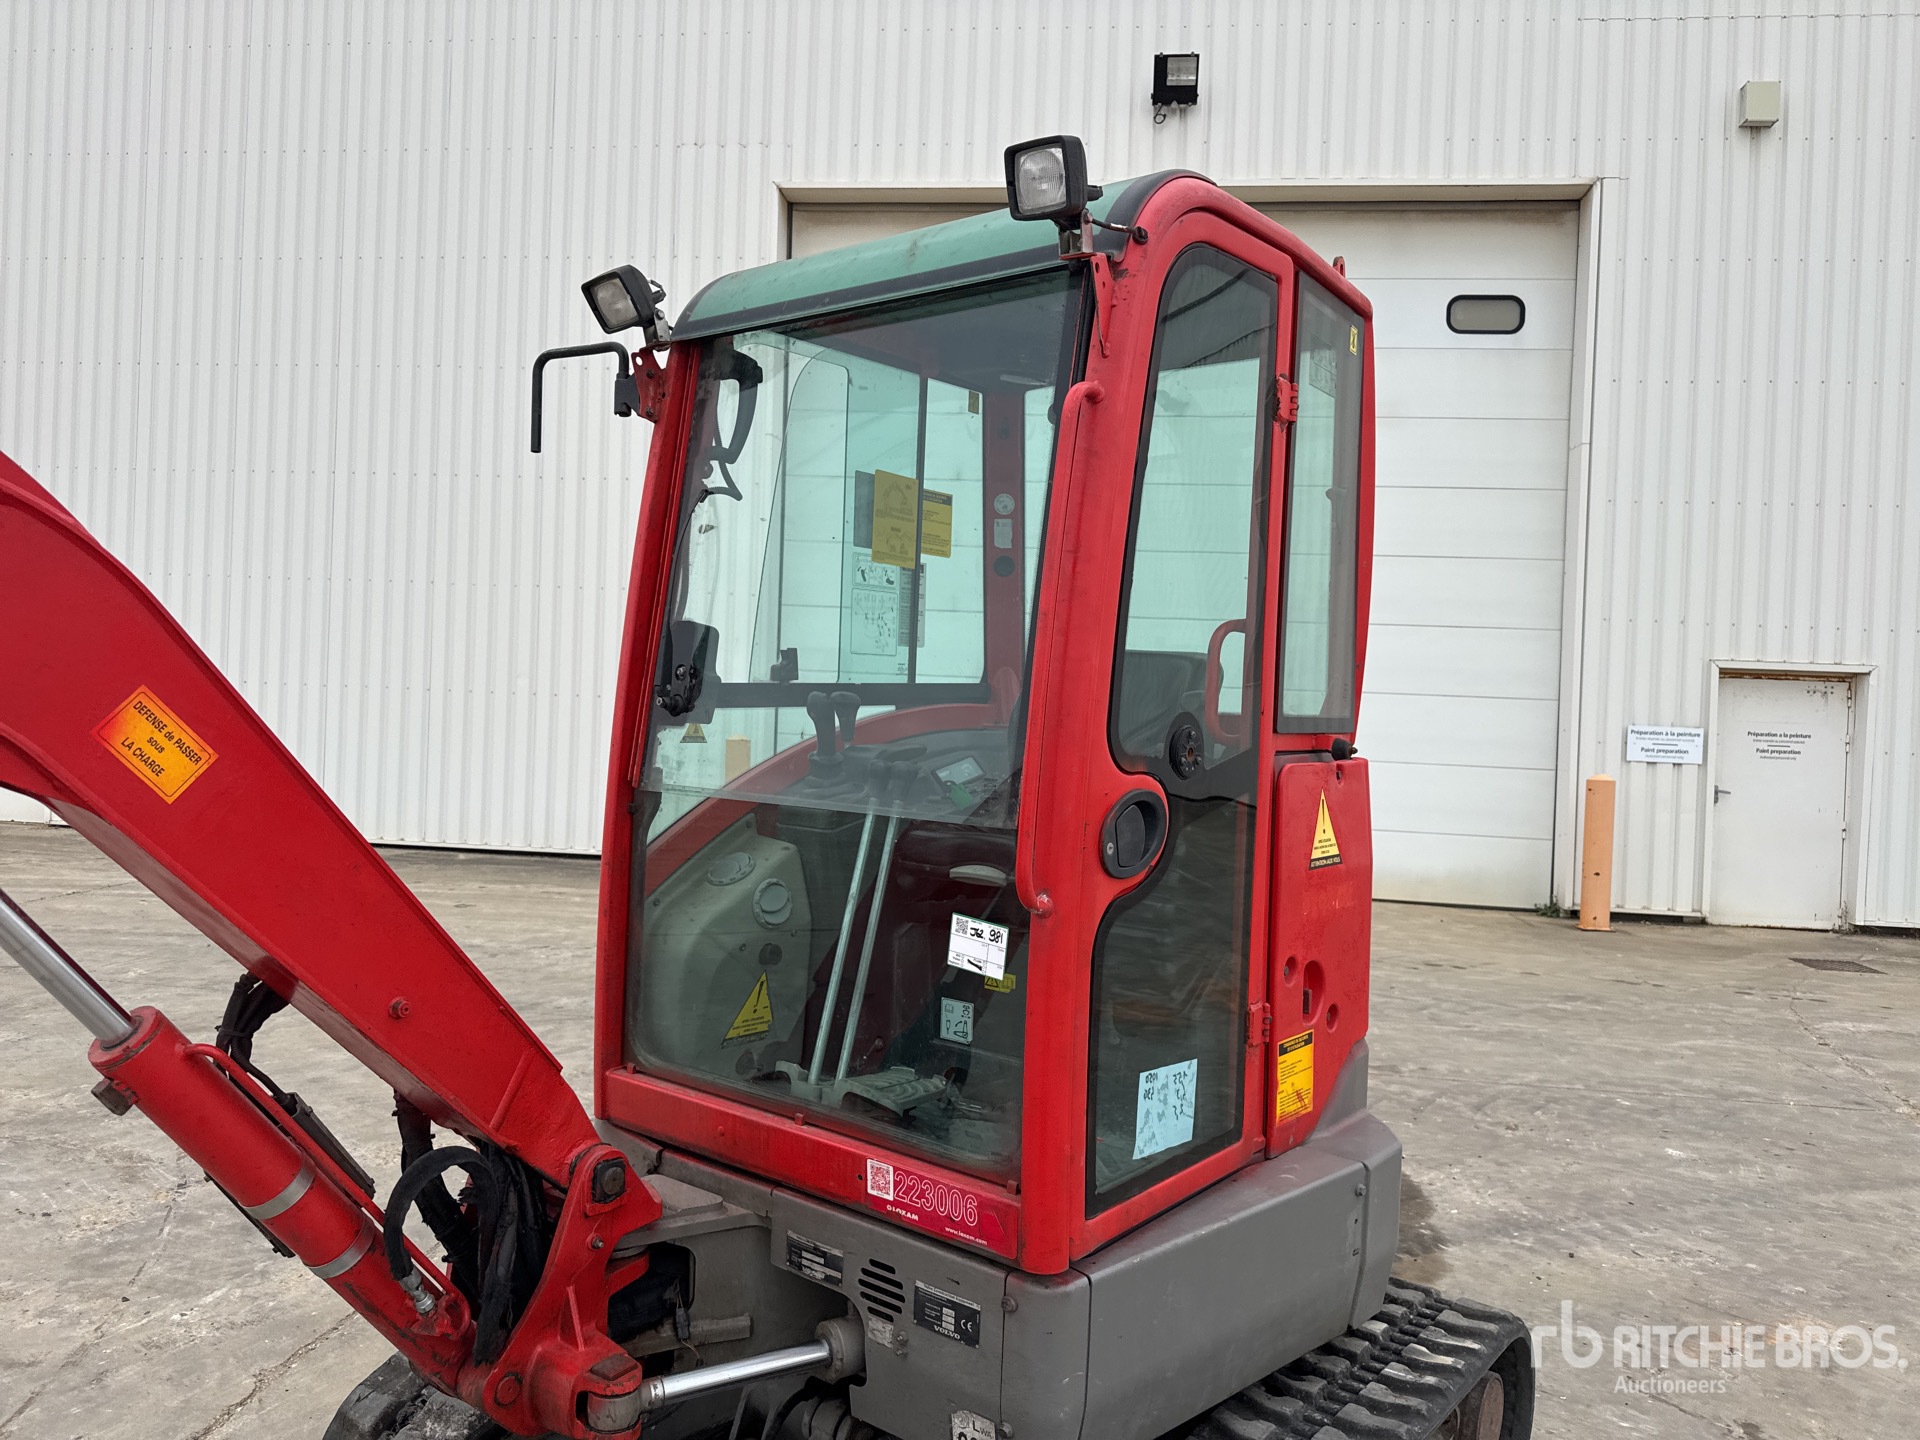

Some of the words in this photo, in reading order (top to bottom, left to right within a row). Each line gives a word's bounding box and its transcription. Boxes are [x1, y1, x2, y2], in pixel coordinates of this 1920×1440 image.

[133, 701, 167, 733] DEFENSE
[164, 731, 174, 742] de
[173, 738, 202, 766] PASSER
[147, 737, 166, 753] sous
[121, 737, 135, 751] LA
[132, 747, 165, 777] CHARGE
[894, 1171, 978, 1226] 223006
[934, 1325, 960, 1340] VOLVO
